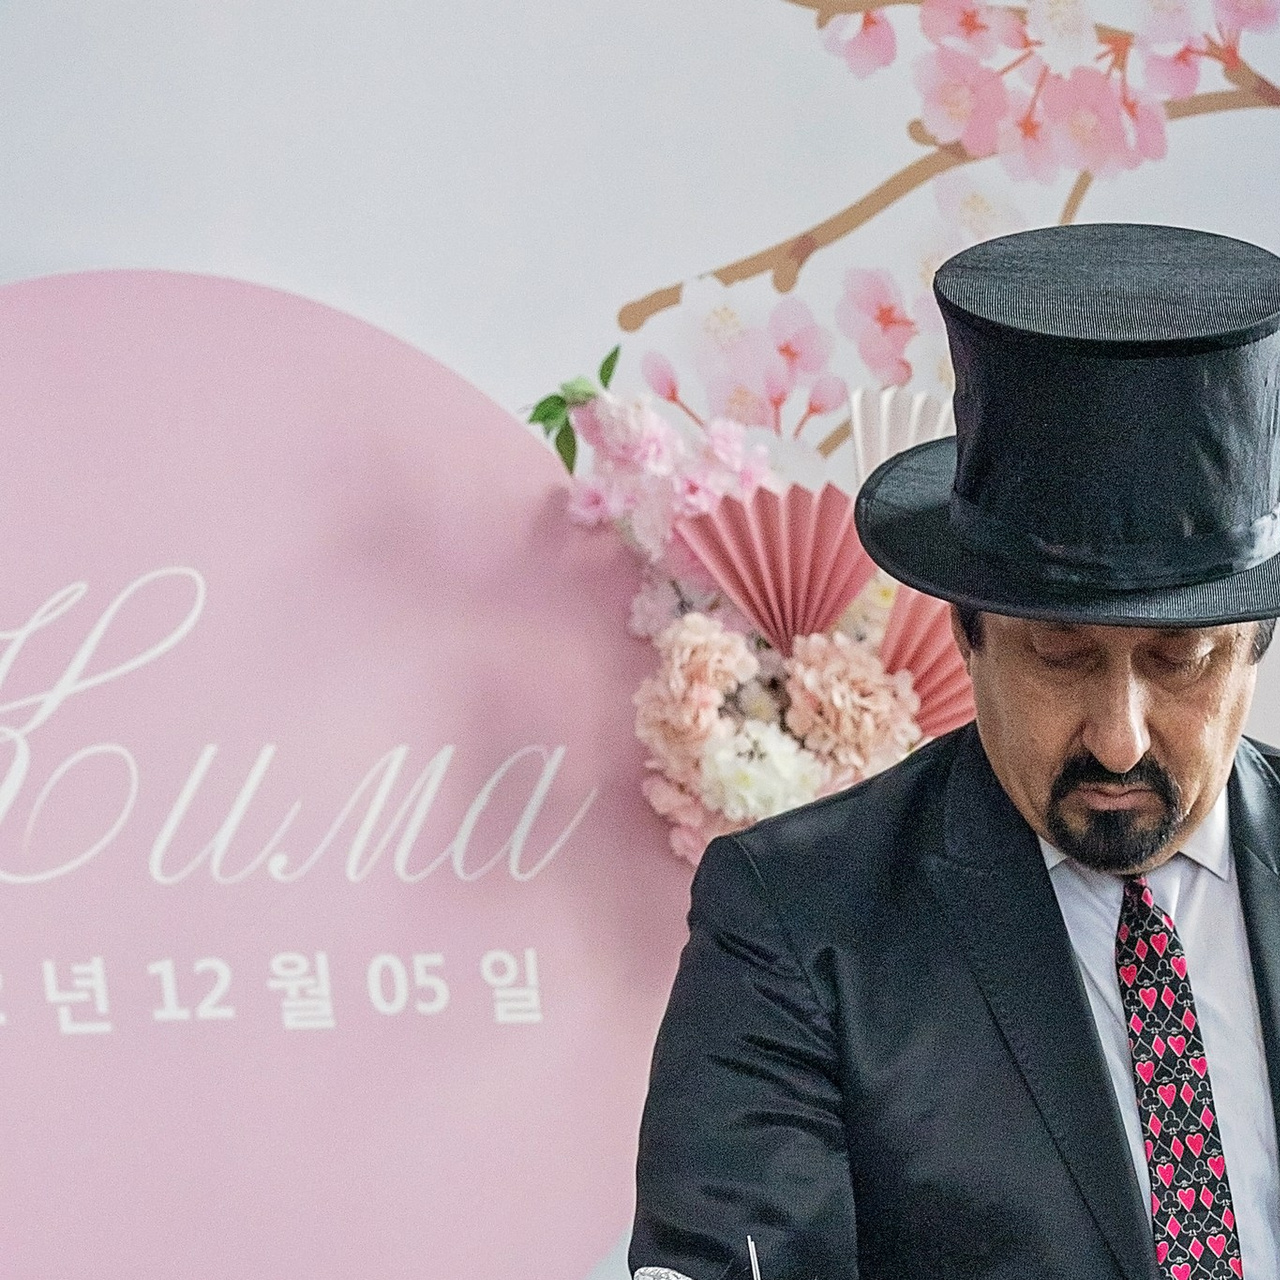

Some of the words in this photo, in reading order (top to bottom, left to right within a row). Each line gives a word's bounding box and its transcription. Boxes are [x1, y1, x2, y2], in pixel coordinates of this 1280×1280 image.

[42, 955, 112, 1035] 년
[147, 957, 236, 1021] 12
[267, 950, 336, 1031] 월
[366, 952, 451, 1016] 05
[480, 948, 544, 1024] 일
